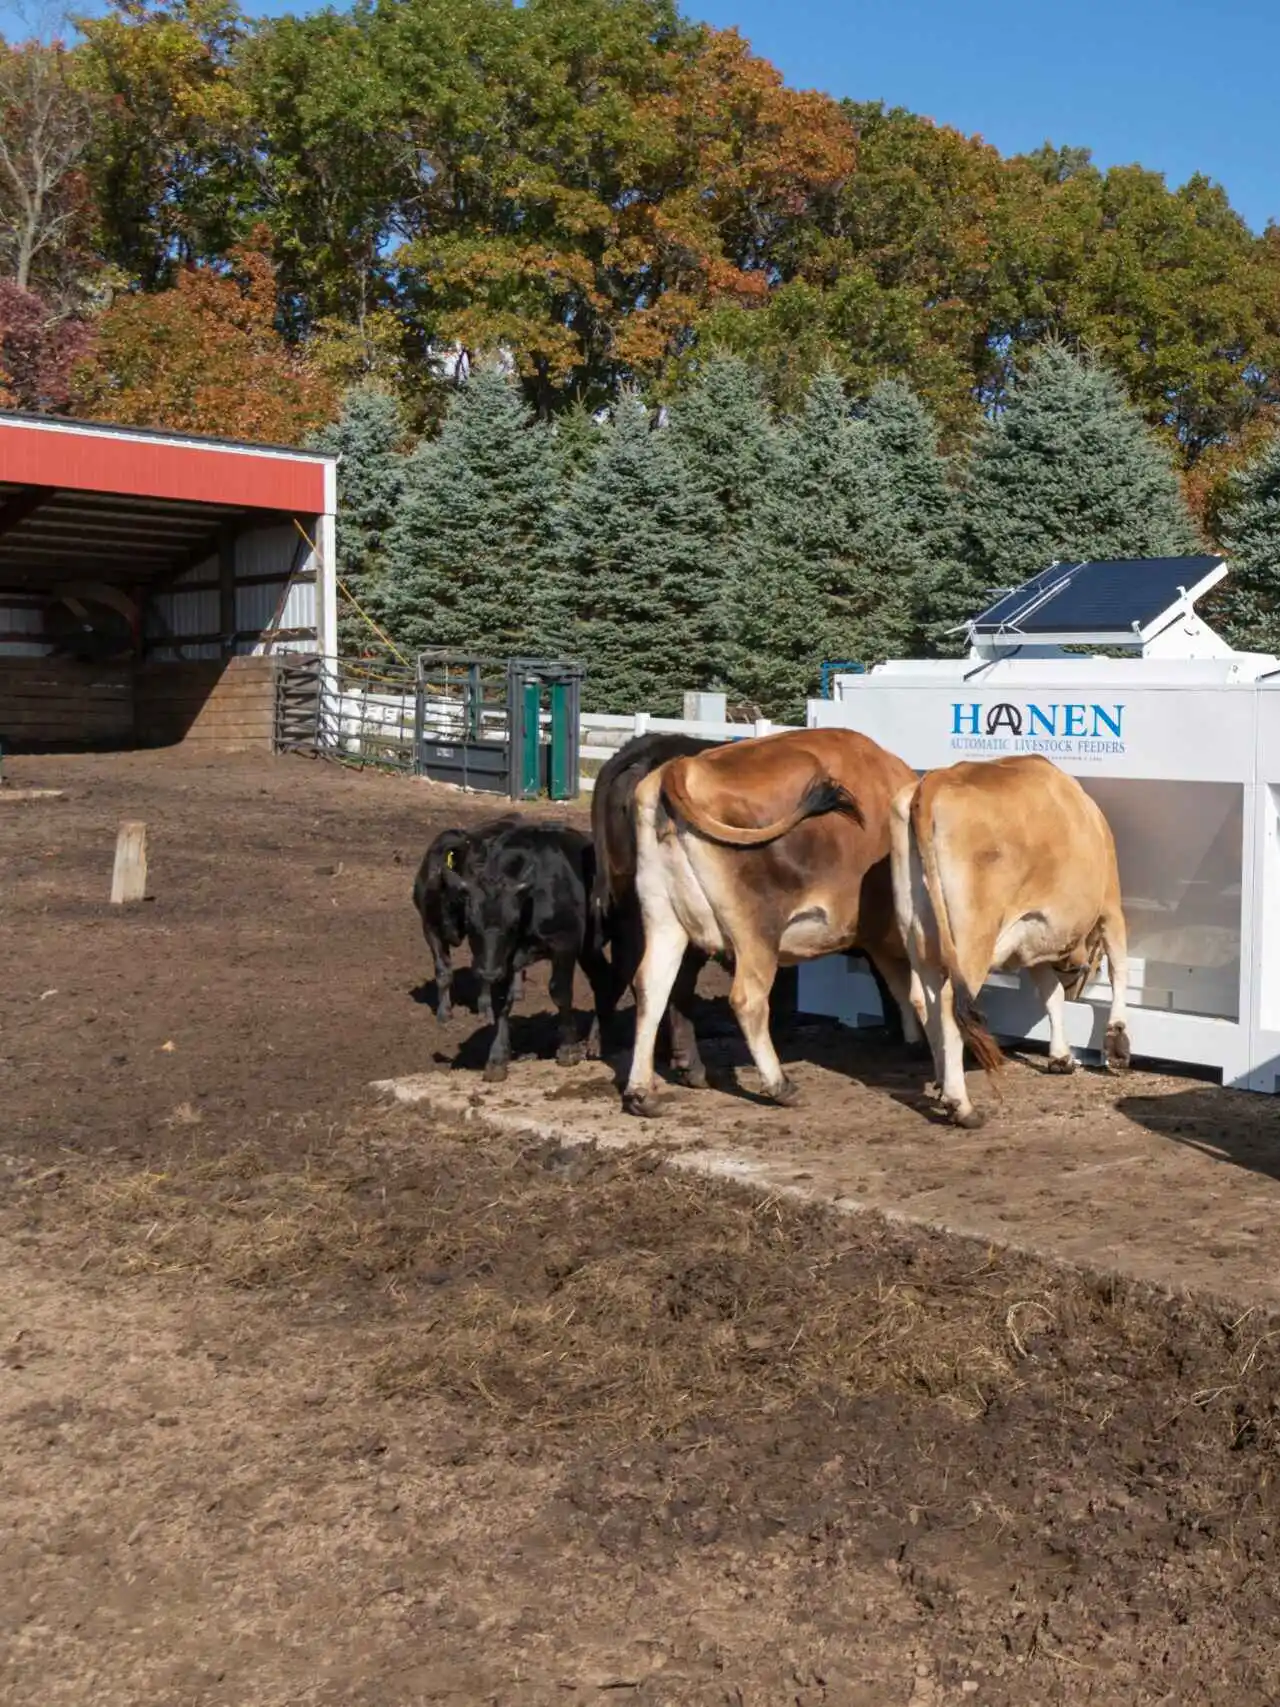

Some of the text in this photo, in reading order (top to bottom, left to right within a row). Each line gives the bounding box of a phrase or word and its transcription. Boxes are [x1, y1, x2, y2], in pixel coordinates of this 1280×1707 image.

[950, 703, 1126, 738] HANEN
[950, 737, 1126, 755] AUTOMATIC LIVESTOCK FEEDERS
